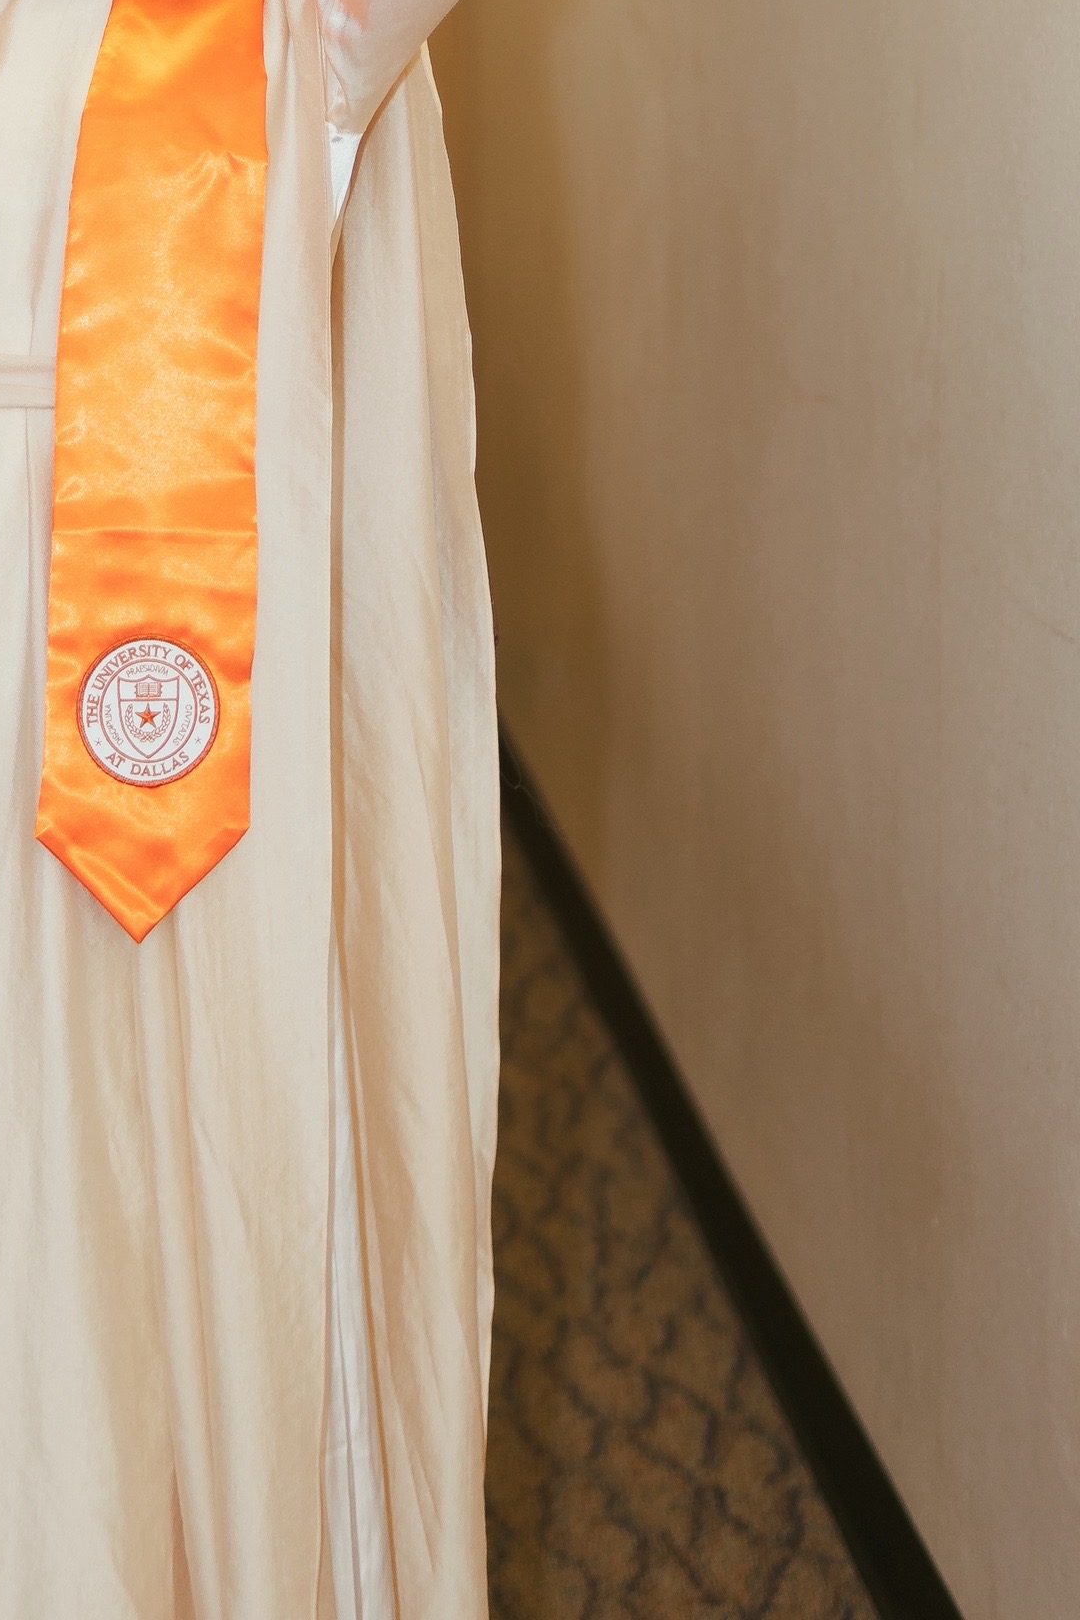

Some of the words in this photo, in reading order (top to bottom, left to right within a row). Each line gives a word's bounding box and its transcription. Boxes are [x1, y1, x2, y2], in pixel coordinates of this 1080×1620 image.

[92, 644, 172, 691] UNIVERSITY
[174, 654, 194, 671] OF
[86, 694, 100, 728] THE
[190, 670, 211, 725] TEXAS
[105, 752, 126, 769] AT
[129, 751, 189, 777] DALLAS
